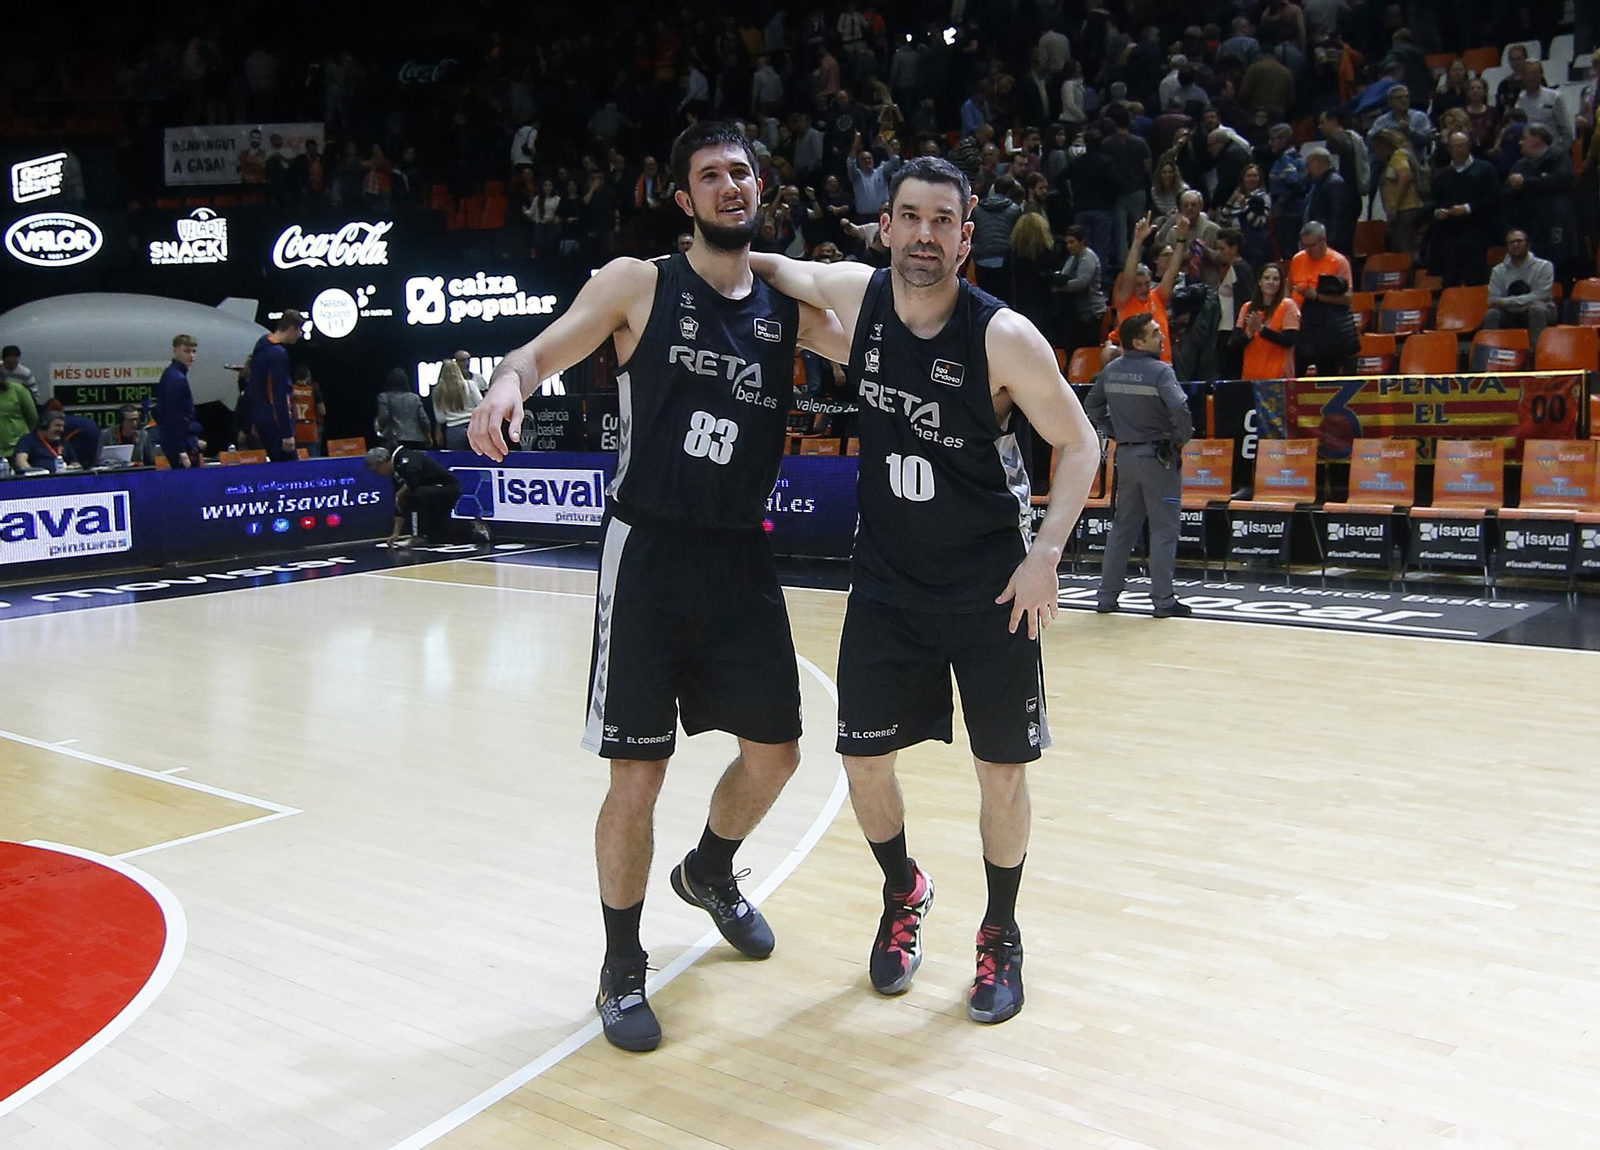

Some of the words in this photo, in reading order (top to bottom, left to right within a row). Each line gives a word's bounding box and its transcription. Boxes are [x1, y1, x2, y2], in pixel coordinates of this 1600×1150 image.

[173, 161, 183, 174] A
[14, 229, 93, 252] VALOR
[271, 220, 394, 270] Coca-Cola
[448, 271, 518, 297] caixa
[448, 291, 557, 322] popular
[53, 365, 81, 380] MÉS
[85, 368, 110, 379] QUE
[113, 367, 131, 378] UN
[135, 366, 163, 376] TRIP
[668, 345, 763, 394] RETA
[116, 386, 157, 402] TRIPL
[1378, 376, 1507, 396] PENYA
[735, 385, 778, 410] bet.es
[796, 398, 843, 414] valencia
[859, 378, 941, 429] RETA
[536, 409, 569, 422] valencia
[1414, 402, 1450, 425] EL
[536, 424, 564, 438] basket
[682, 410, 740, 466] 83
[537, 437, 556, 449] club
[885, 452, 937, 503] 10
[497, 470, 603, 508] isaval
[201, 488, 381, 520] www.isaval.es
[555, 511, 603, 523] pinturas
[1249, 521, 1285, 534] isaval
[1345, 523, 1384, 537] isaval
[1438, 523, 1481, 538] isaval
[1525, 531, 1570, 547] isaval
[31, 556, 357, 602] movistar
[1203, 583, 1246, 591] de
[1258, 584, 1392, 601] Valencia
[1402, 594, 1530, 611] Basket
[852, 731, 862, 739] EL
[862, 727, 897, 739] CORREO
